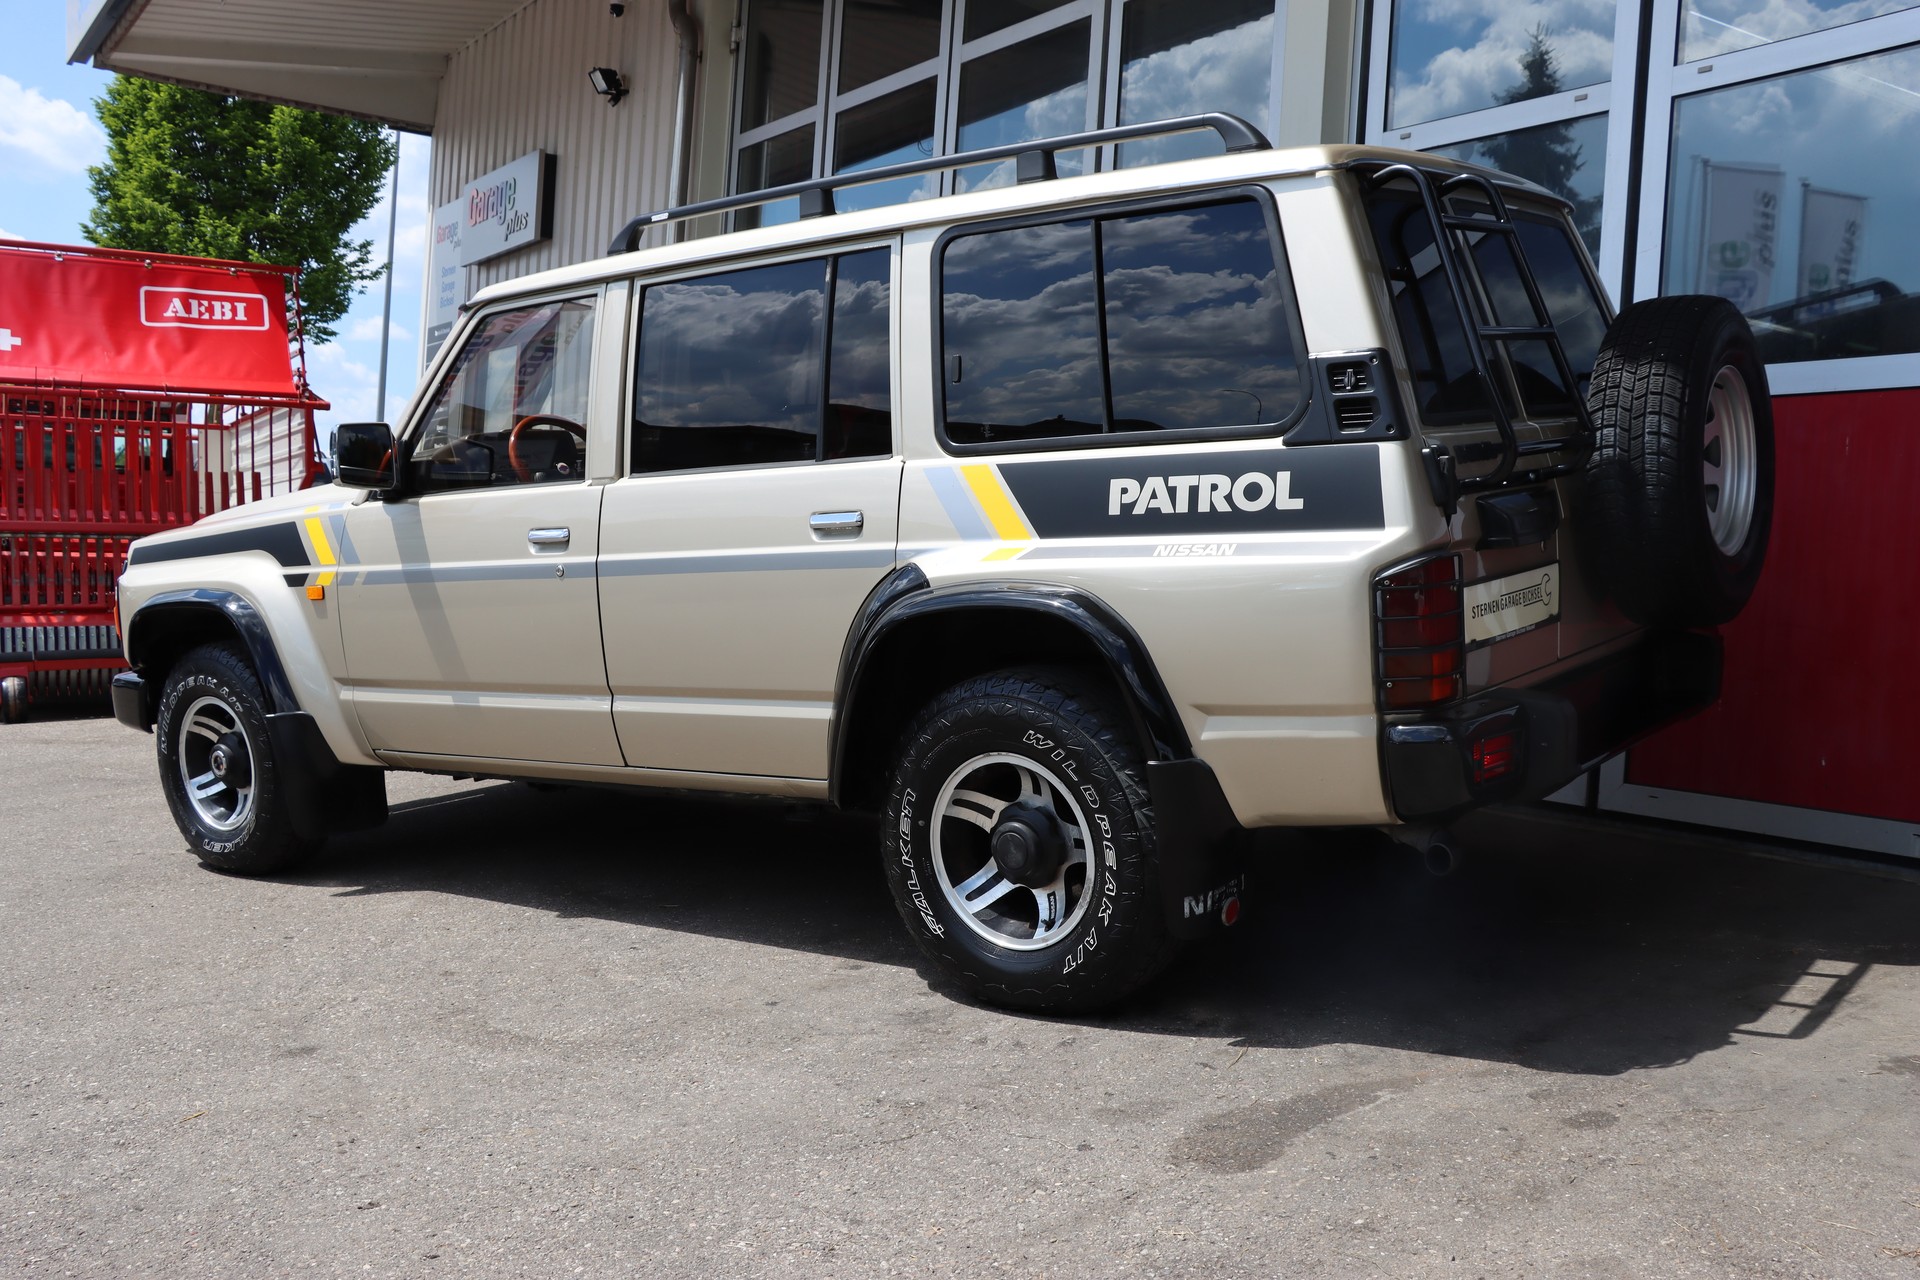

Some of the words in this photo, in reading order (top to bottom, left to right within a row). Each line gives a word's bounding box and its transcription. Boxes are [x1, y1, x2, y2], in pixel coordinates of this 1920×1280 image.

[467, 177, 517, 227] Garage
[437, 221, 459, 244] Garage
[504, 210, 529, 242] plus
[163, 297, 248, 321] AEBI
[1108, 470, 1304, 516] PATROL
[1152, 543, 1238, 557] NISSAN
[1472, 599, 1500, 619] STERNEN
[1500, 593, 1522, 611] GARAGE
[1522, 587, 1543, 604] BICHSEL
[899, 788, 945, 938] FALKEN
